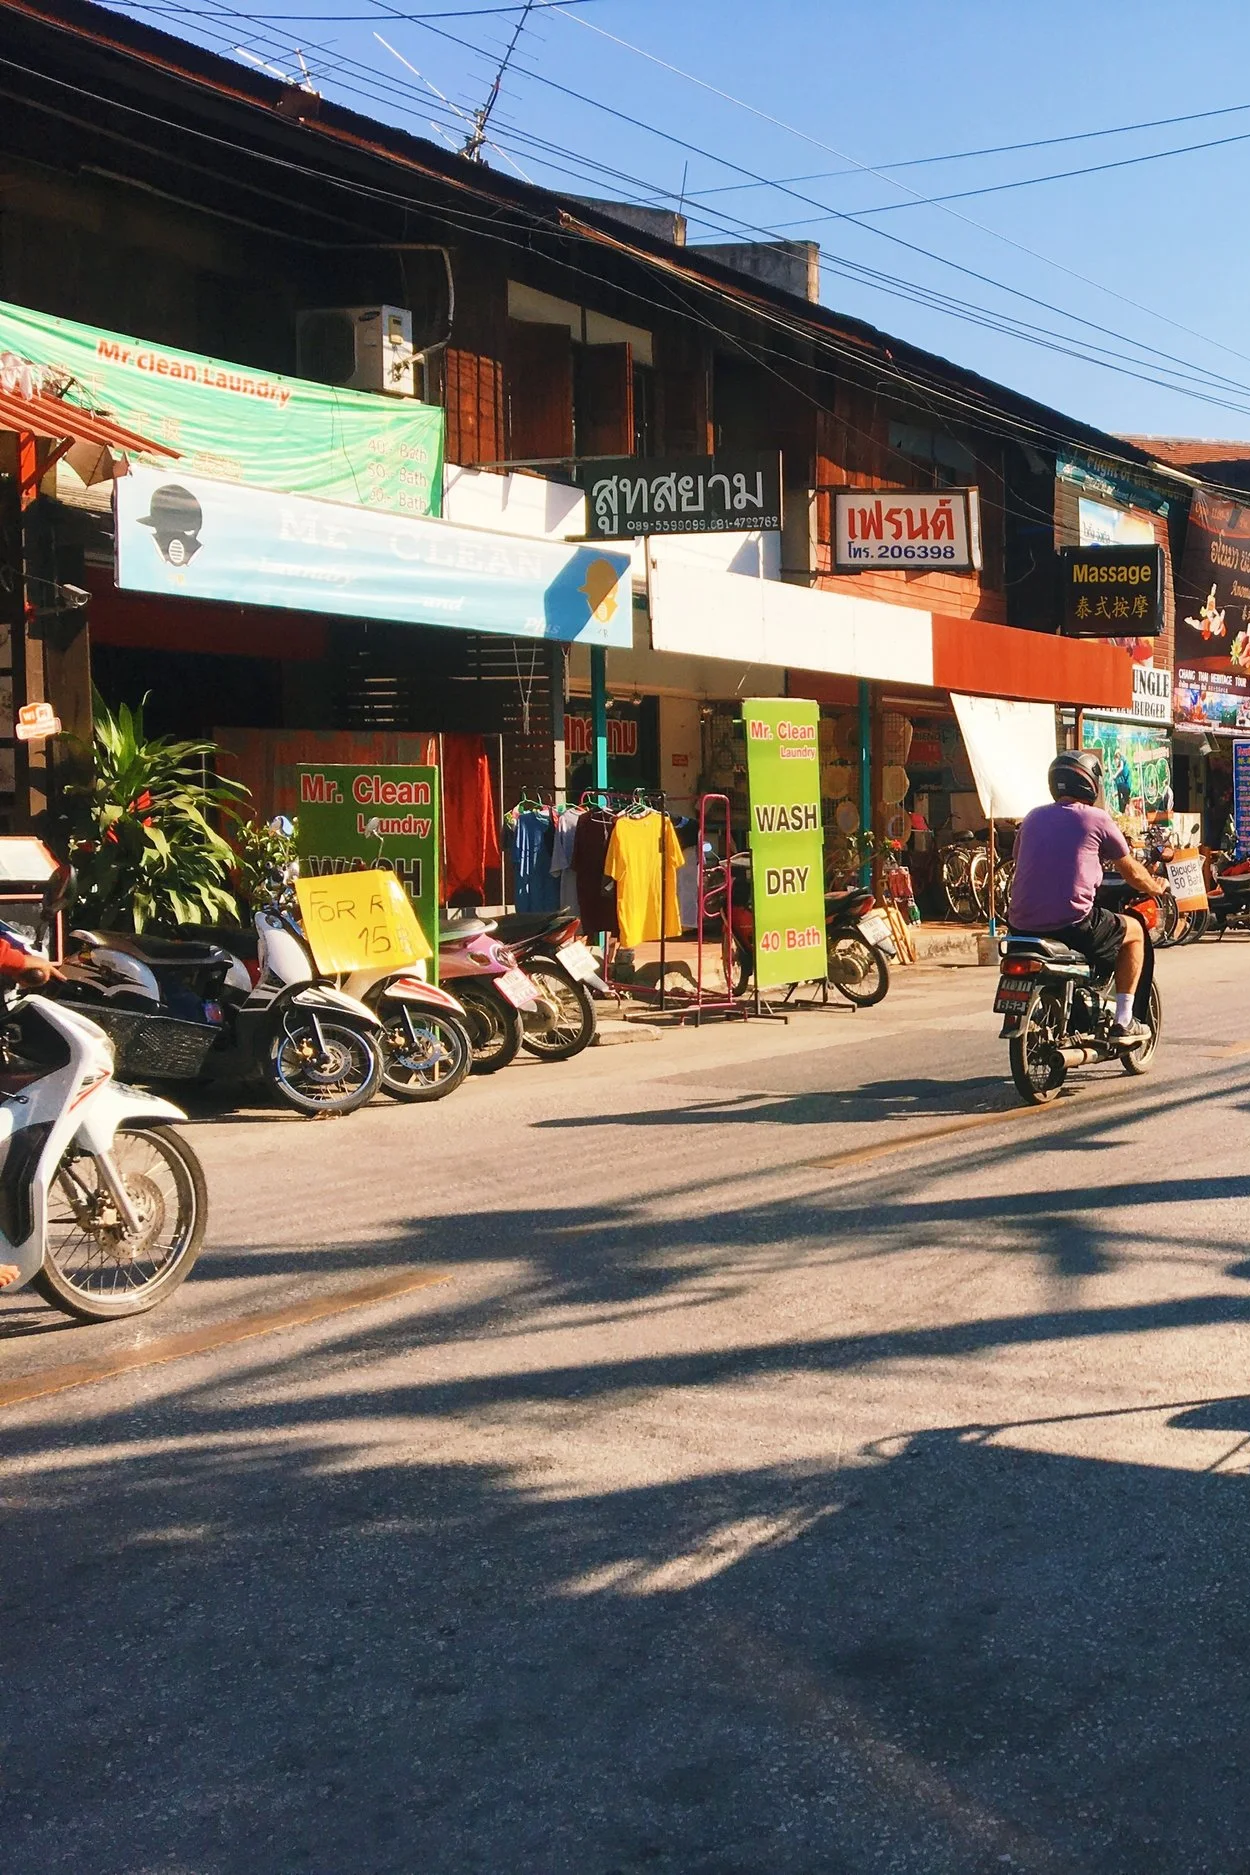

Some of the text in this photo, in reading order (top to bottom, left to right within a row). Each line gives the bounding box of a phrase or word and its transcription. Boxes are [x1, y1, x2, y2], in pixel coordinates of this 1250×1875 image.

[202, 366, 292, 408] Laundry
[592, 472, 764, 535] สูทสยาม
[847, 499, 955, 540] เฟรนด์
[390, 531, 543, 580] CLEAN
[847, 541, 955, 559] โทร. 206398
[1072, 564, 1152, 585] Massage
[421, 595, 466, 612] and
[1074, 594, 1149, 620] 泰式按摩
[1178, 668, 1196, 681] CHANG
[1198, 671, 1209, 682] THAI
[1210, 673, 1233, 686] HERITAGE
[1235, 676, 1247, 687] TOUR
[750, 719, 816, 741] Mr. Clean
[780, 745, 816, 760] Laundry
[300, 772, 431, 805] Mr. Clean
[755, 803, 818, 833] WASH
[766, 866, 810, 896] DRY
[1170, 863, 1198, 877] Bicycle
[1173, 877, 1186, 890] 50
[308, 890, 356, 923] FOR
[760, 926, 821, 952] 40 Bath
